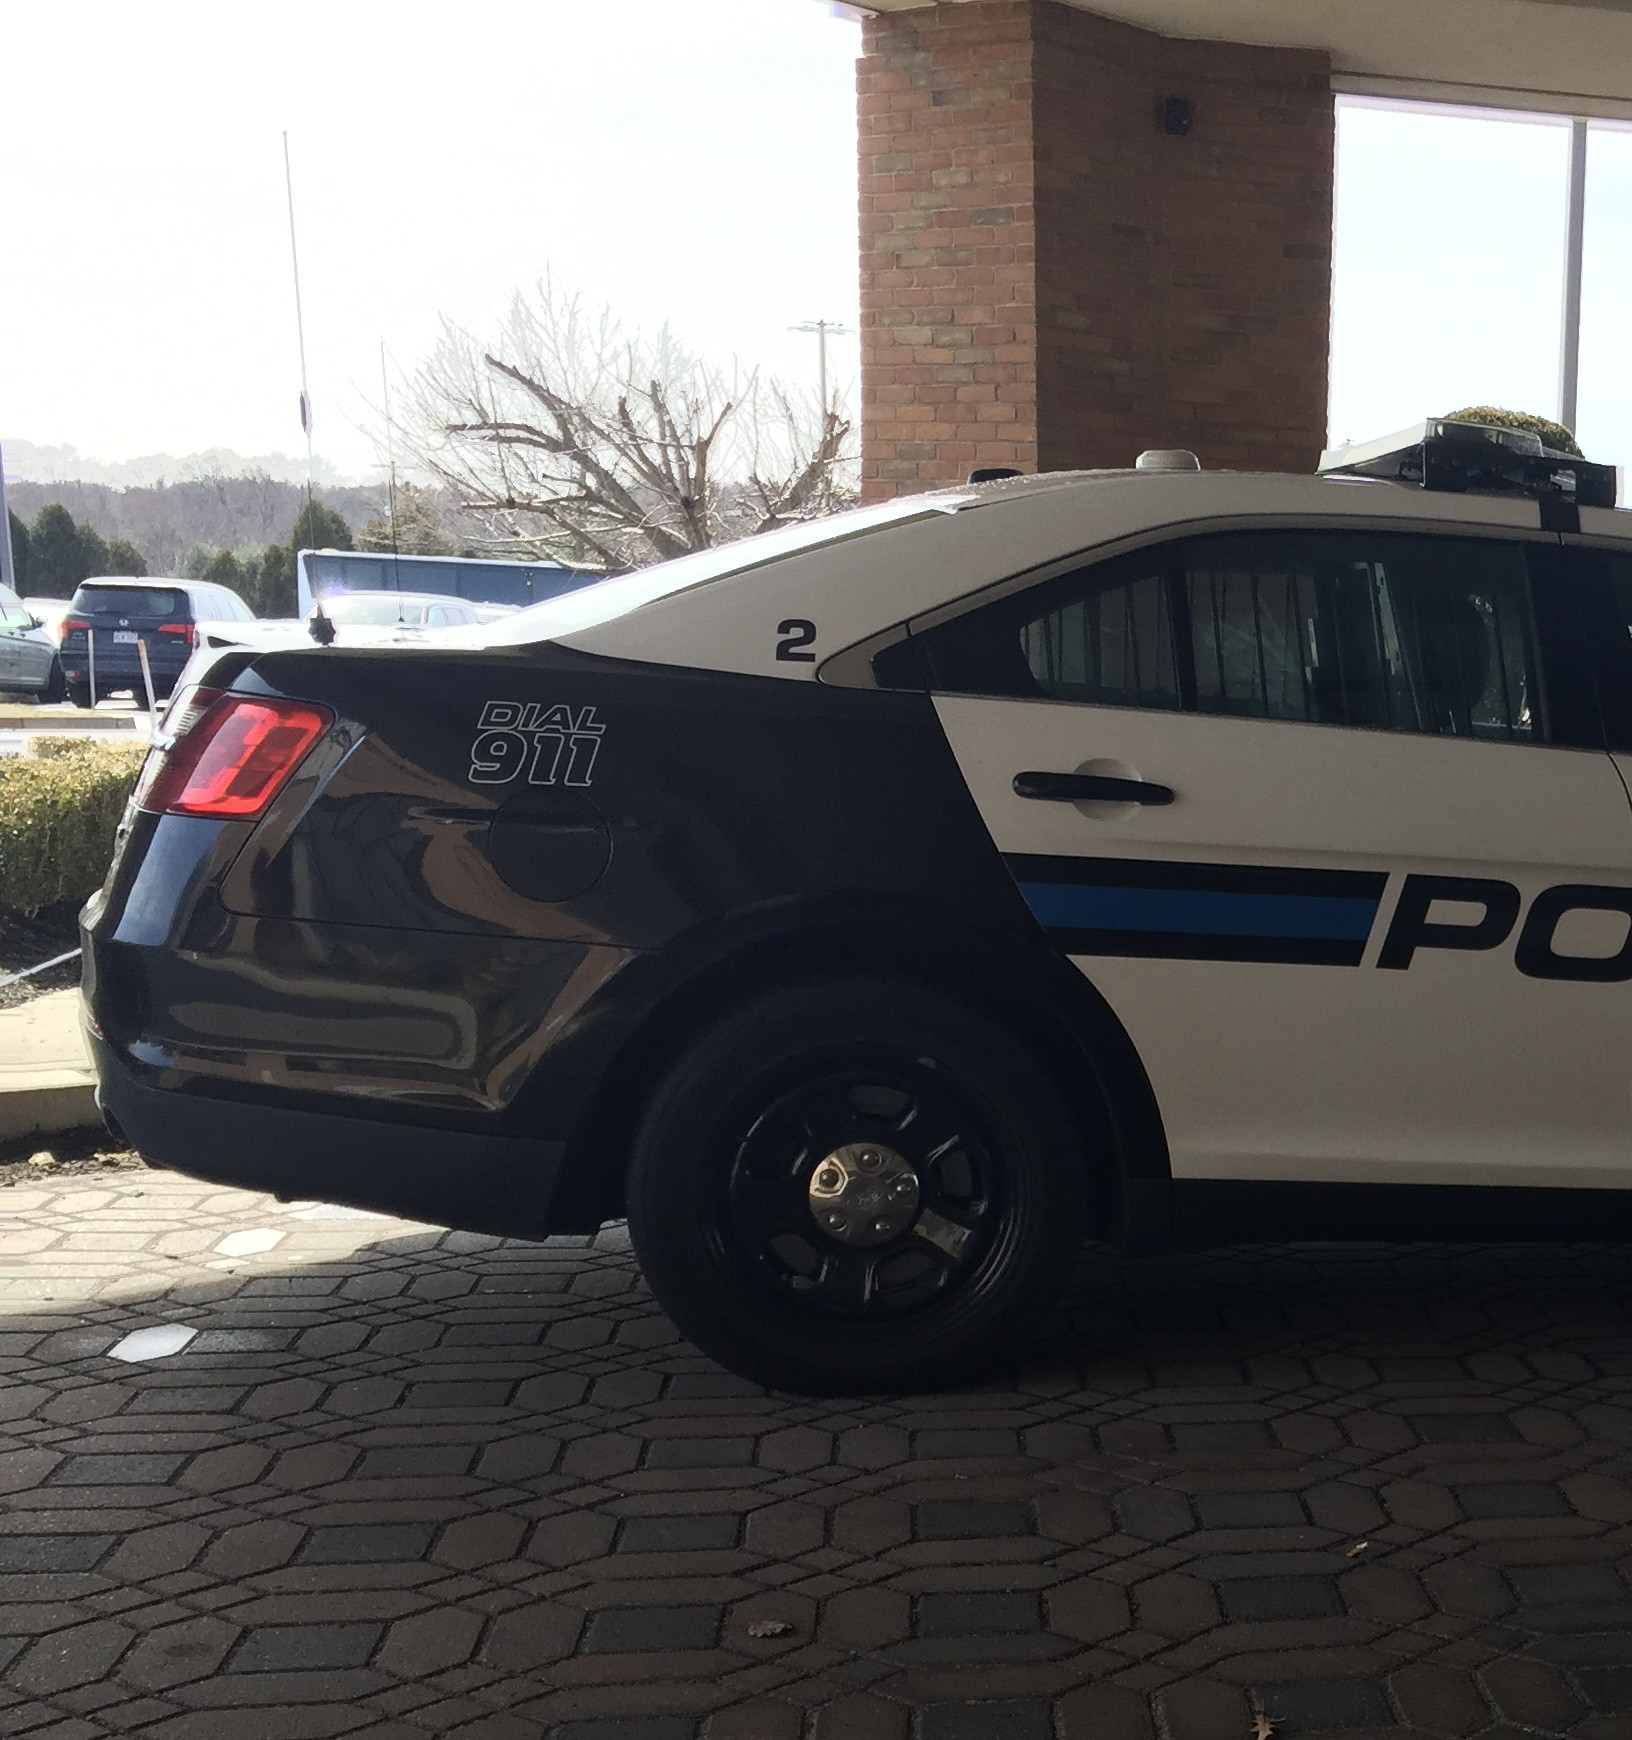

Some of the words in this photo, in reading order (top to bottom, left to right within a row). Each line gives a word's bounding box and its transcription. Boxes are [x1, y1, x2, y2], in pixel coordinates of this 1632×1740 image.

[775, 619, 816, 662] 2
[477, 700, 606, 734] DIAL
[468, 730, 600, 787] 911
